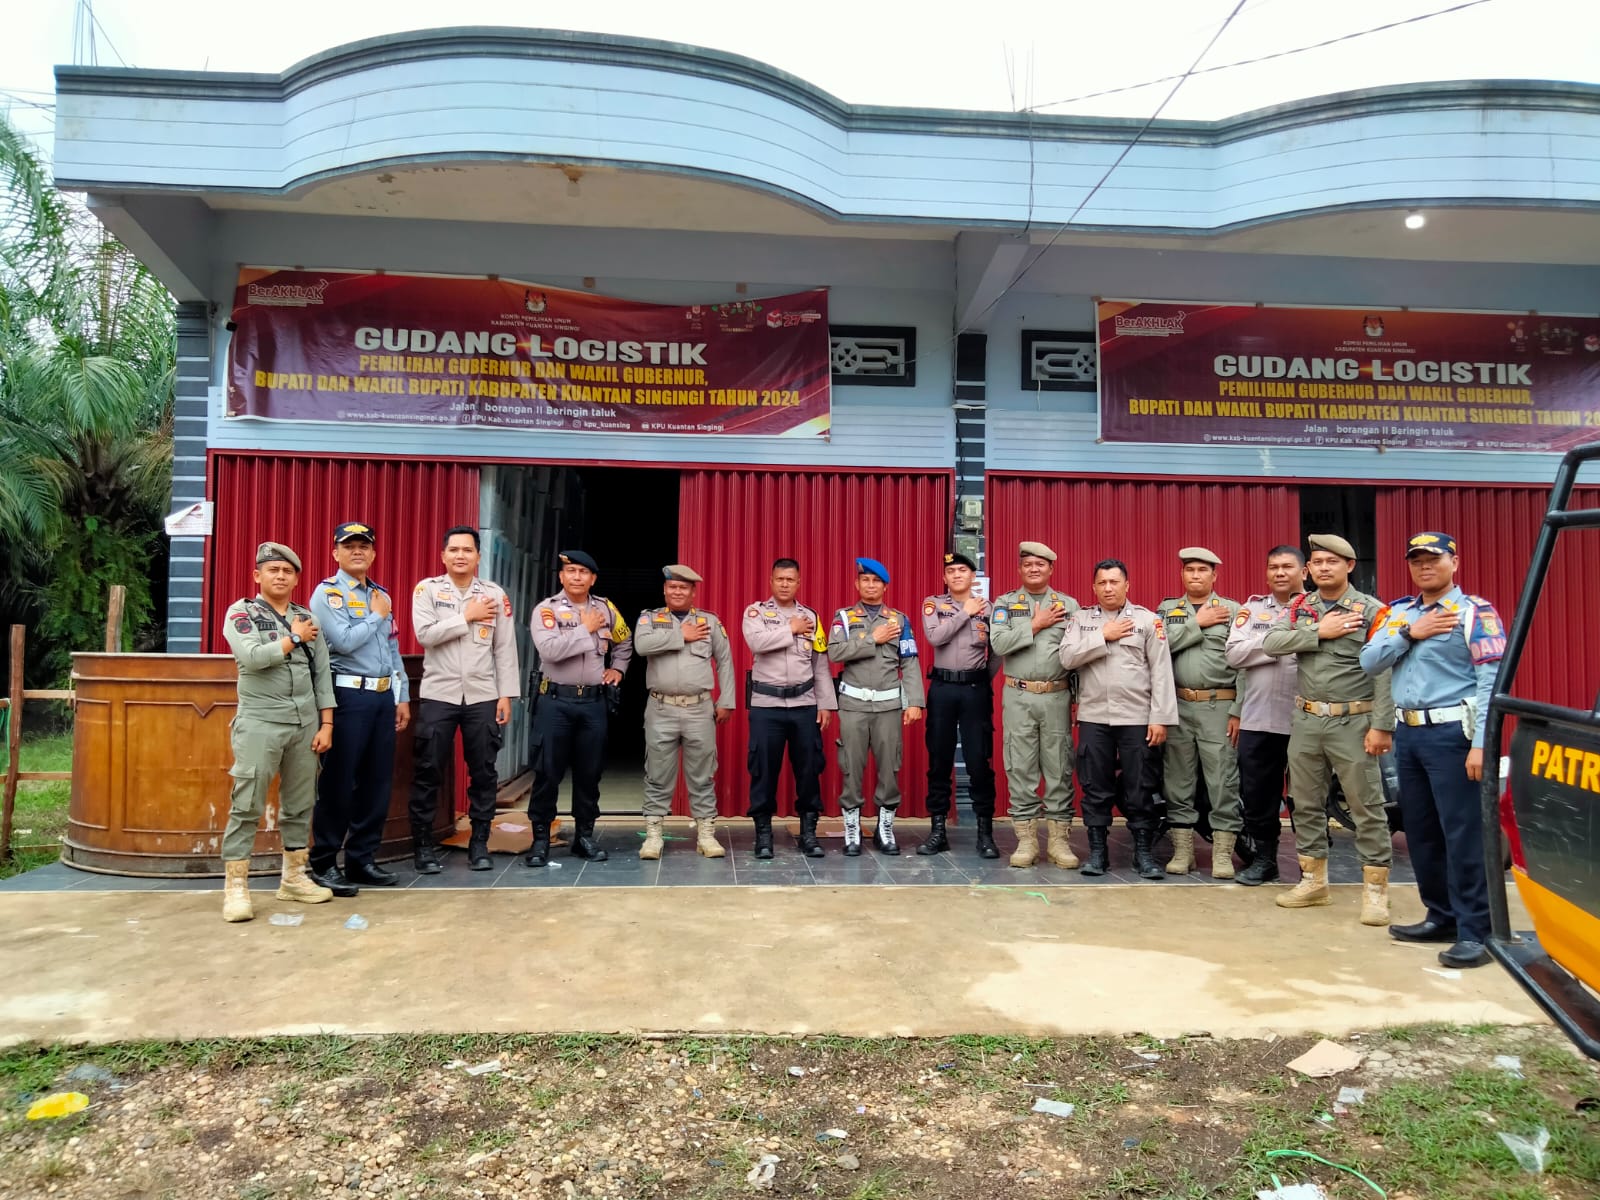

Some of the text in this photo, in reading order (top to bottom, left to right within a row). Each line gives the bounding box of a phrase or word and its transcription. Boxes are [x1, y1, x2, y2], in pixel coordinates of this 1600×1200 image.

[248, 281, 326, 299] BerAKHLAK
[1115, 313, 1185, 329] BerAKHLAK
[355, 327, 707, 366] GUDANG LOGISTIK
[359, 355, 709, 387] PEMILIHAN GUBERNUR DAN WAKIL GUBERNUR,
[1213, 354, 1533, 385] GUDANG LOGISTIK
[255, 371, 800, 407] BUPATI DAN WAKIL BUPATI KABUPATEN KUANTAN SINGINGI TAHUN 2024
[1219, 380, 1535, 406] PEMILIHAN GUBERNUR DAN WAKIL GUBERNUR,
[449, 402, 475, 412] Jalan
[484, 402, 533, 415] borangan
[546, 406, 589, 418] Beringin
[591, 407, 617, 417] taluk
[472, 414, 486, 422] KPU
[1129, 399, 1180, 416] BUPATI
[1183, 401, 1213, 416] DAN
[1216, 401, 1263, 418] WAKIL
[1265, 403, 1315, 419] BUPATI
[1319, 404, 1400, 421] KABUPATEN
[1403, 406, 1466, 422] KUANTAN
[1469, 408, 1533, 424] SINGINGI
[1536, 410, 1581, 426] TAHUN
[651, 422, 666, 430] KPU
[1303, 425, 1328, 434] Jalan
[1336, 425, 1379, 436] borangan
[1391, 427, 1429, 437] Beringin
[1432, 427, 1454, 436] taluk
